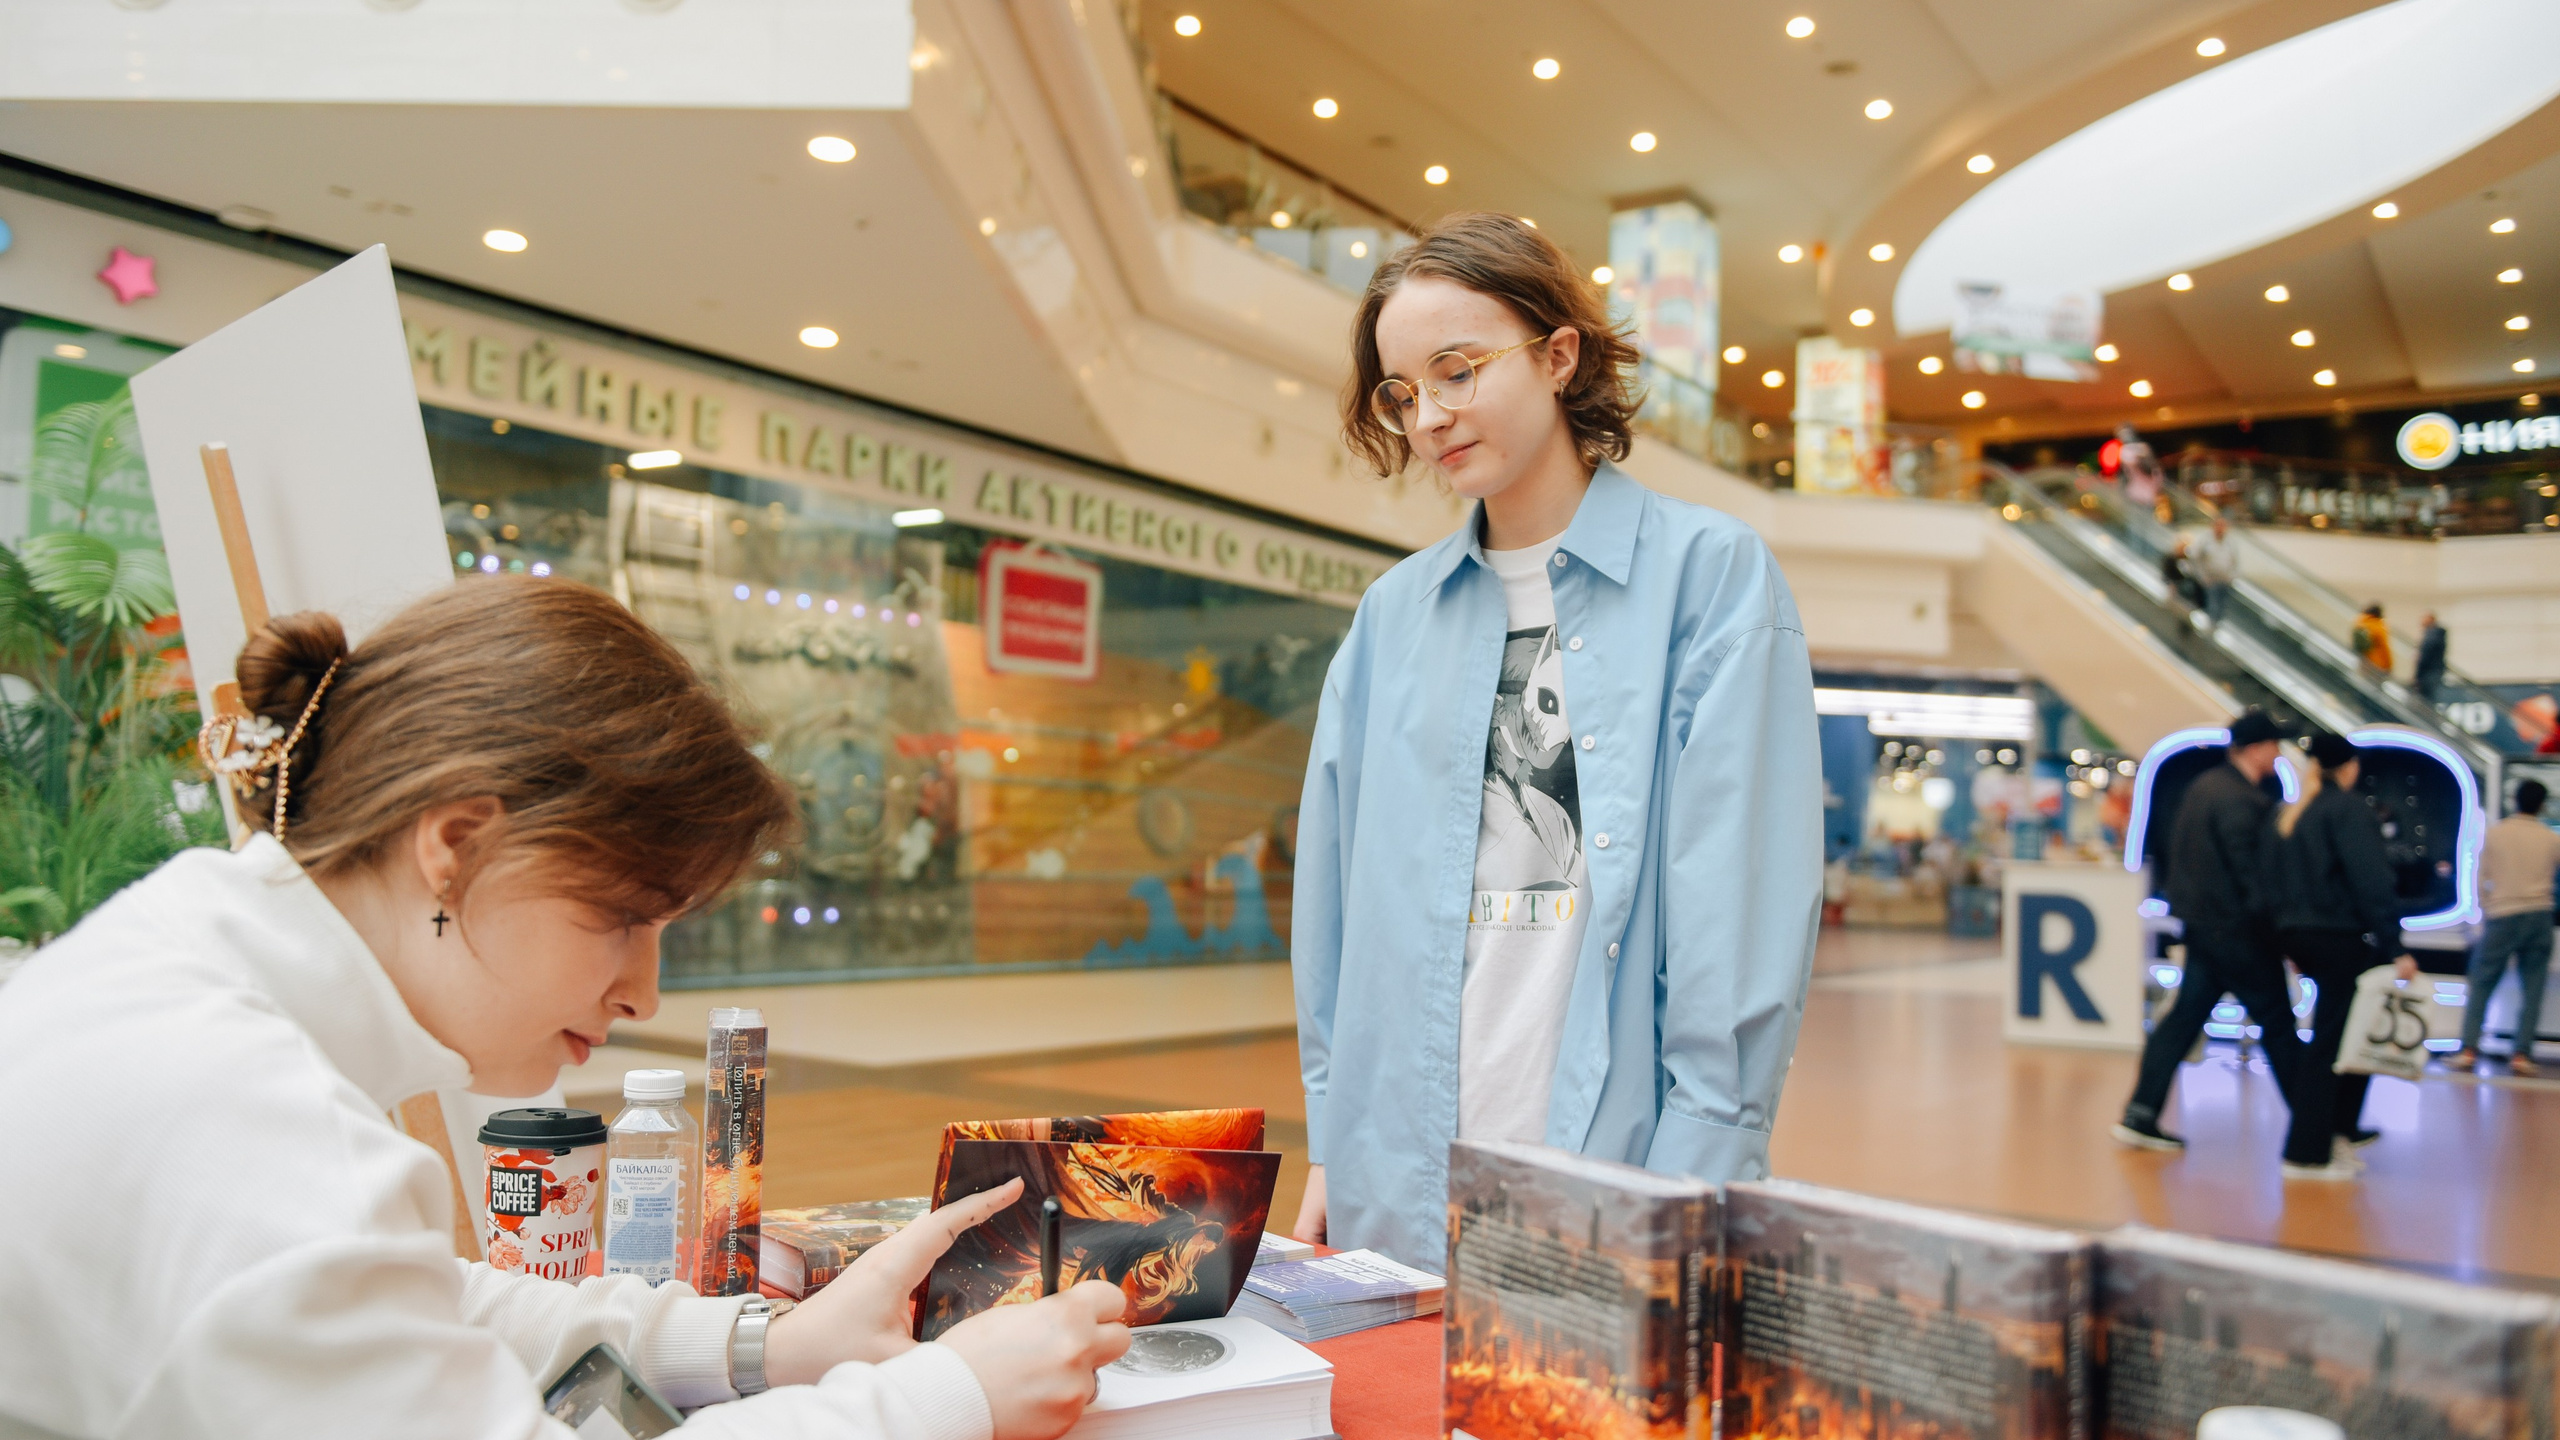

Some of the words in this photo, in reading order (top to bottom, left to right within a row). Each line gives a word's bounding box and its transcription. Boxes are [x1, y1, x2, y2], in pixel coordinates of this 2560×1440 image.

[758, 409, 956, 502] ПАРКИ
[976, 468, 1241, 567] АКТИВНОГО
[1254, 538, 1382, 598] ОТДЫХ
[1469, 892, 1575, 923] BITO
[2018, 892, 2107, 1024] R
[2366, 989, 2429, 1050] 35
[733, 1062, 747, 1109] Топить
[731, 1123, 741, 1154] огне
[733, 1111, 742, 1120] в
[492, 1190, 536, 1212] COFFEE
[498, 1171, 537, 1193] PRICE
[728, 1157, 742, 1230] бушующем
[727, 1232, 738, 1279] печали
